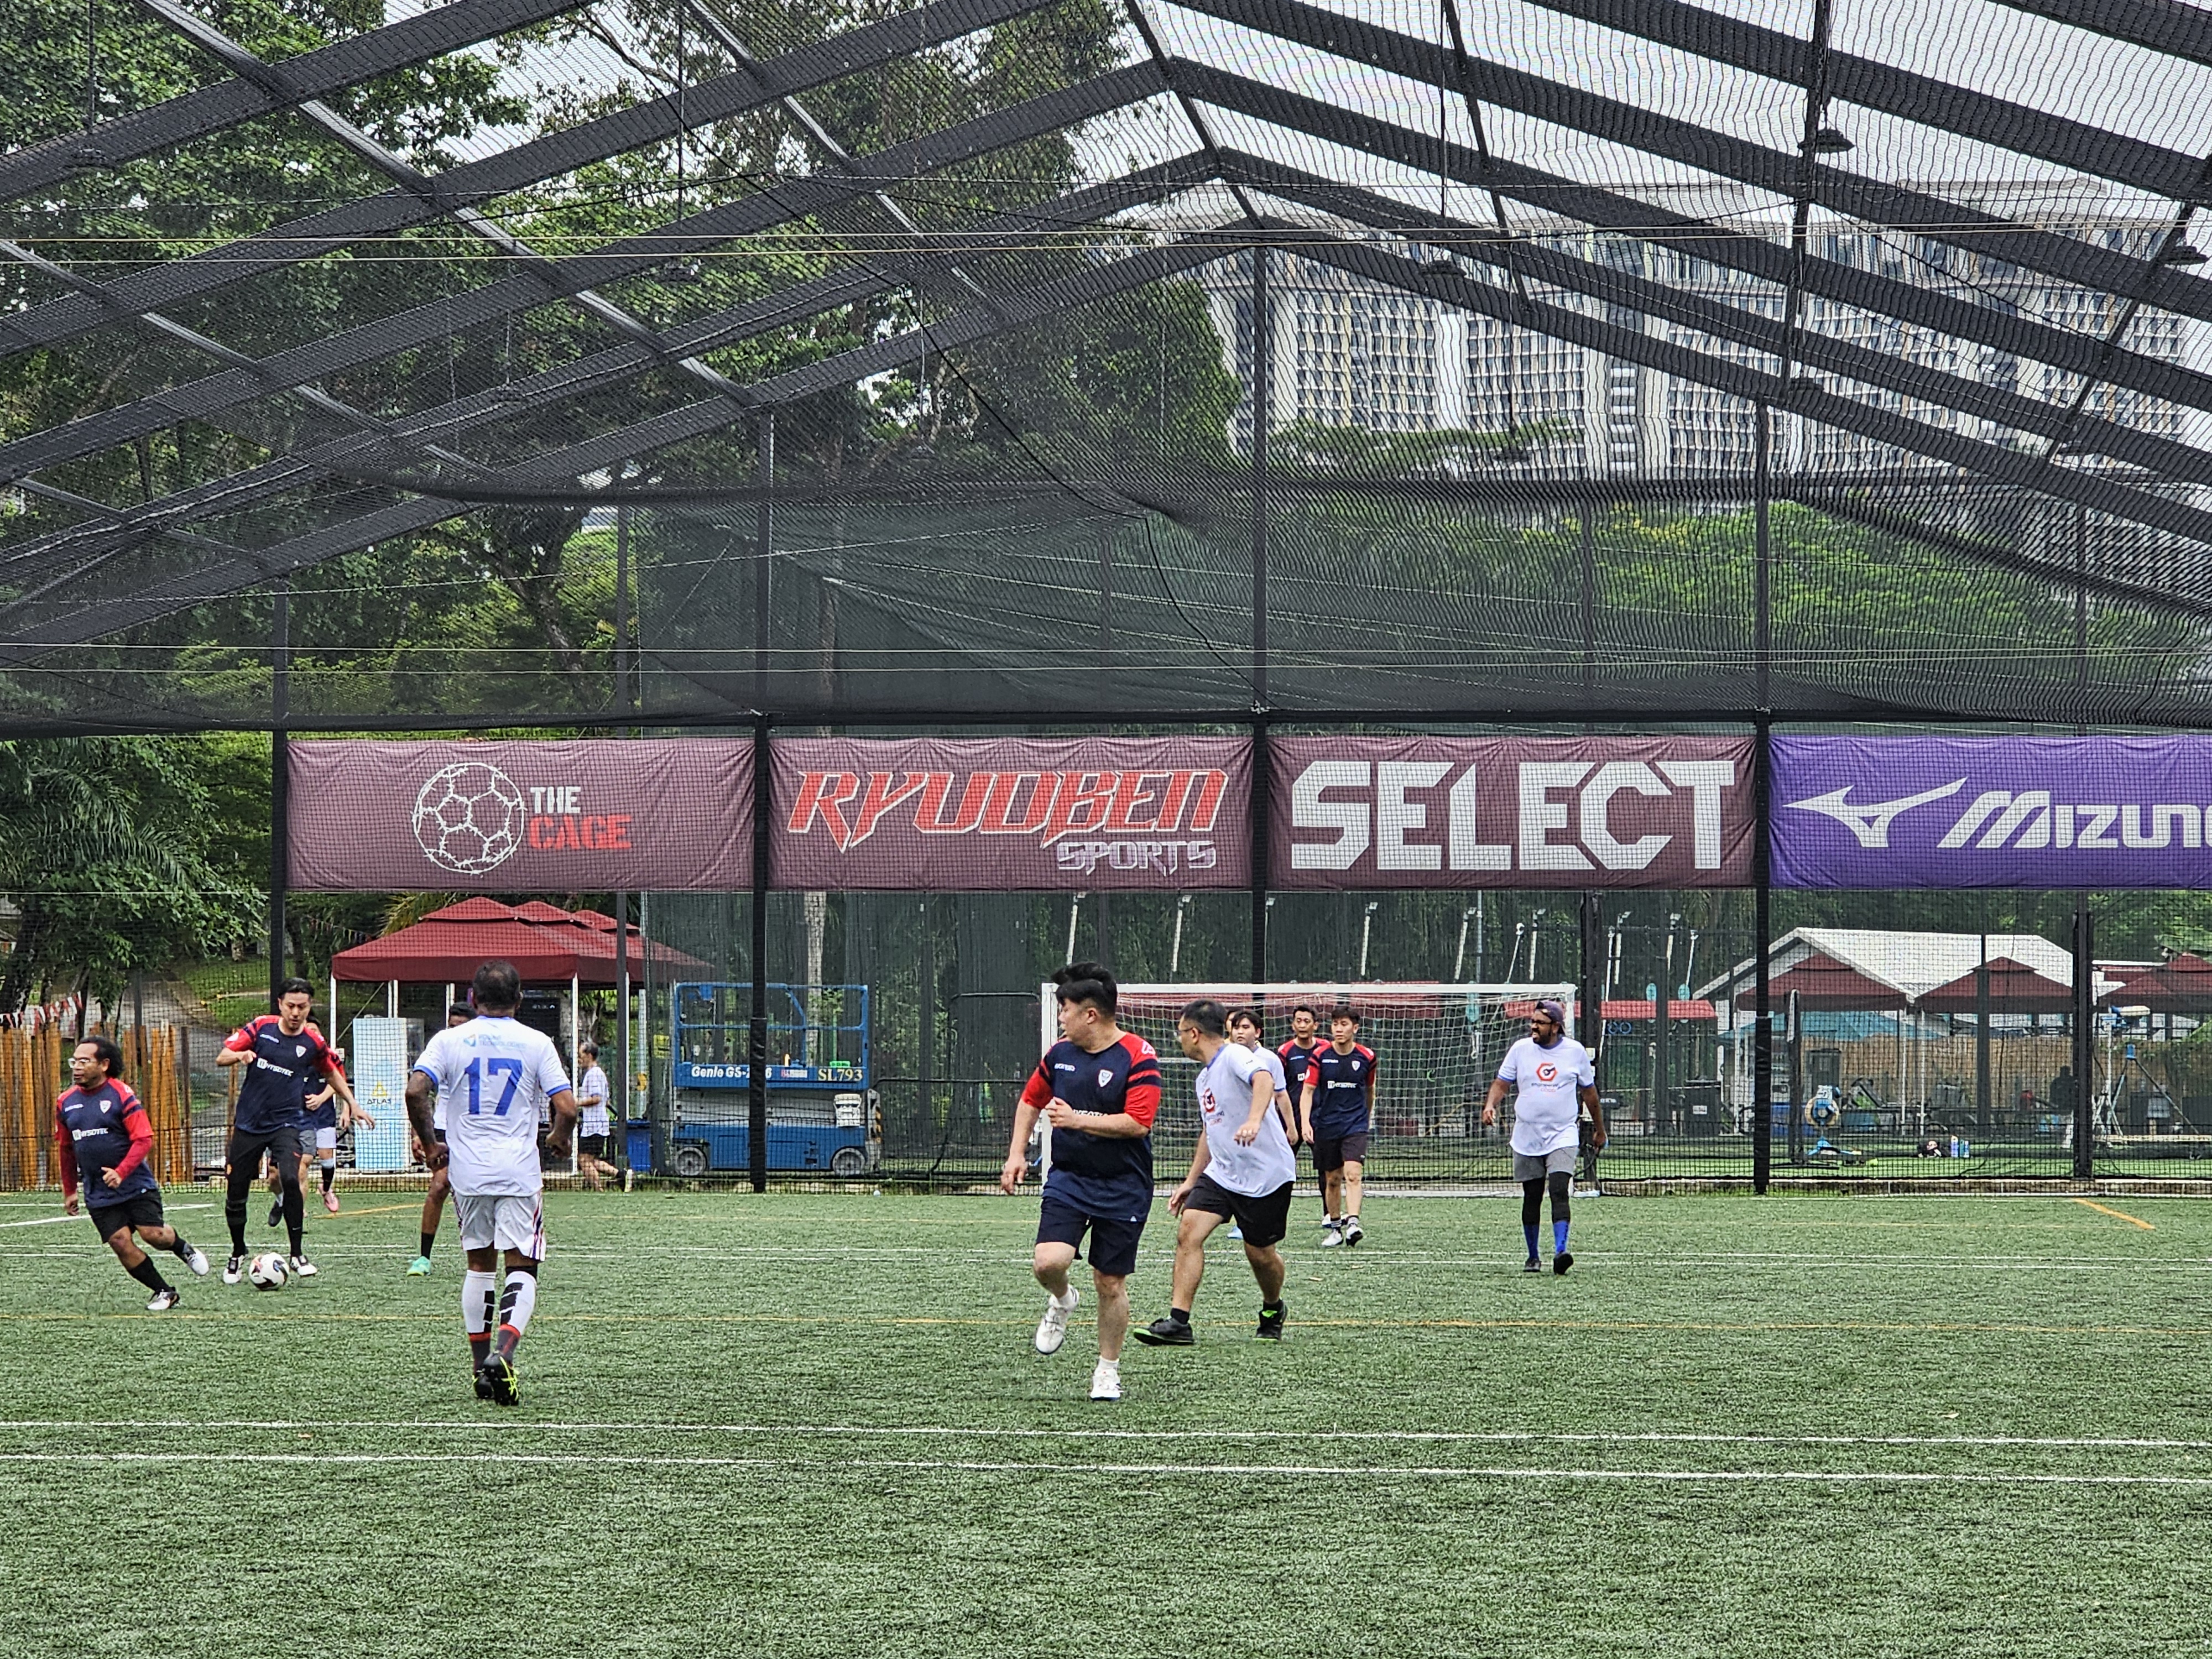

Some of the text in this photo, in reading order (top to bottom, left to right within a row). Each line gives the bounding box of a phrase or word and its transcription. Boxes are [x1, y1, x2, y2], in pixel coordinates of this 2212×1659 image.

[530, 786, 581, 814] THE
[1291, 760, 1735, 870] SELECT
[529, 815, 632, 849] CAGE
[1937, 791, 2212, 848] MIZUN
[1057, 840, 1216, 877] SPORTS
[465, 1057, 523, 1116] 17
[691, 1066, 724, 1078] Genie
[817, 1068, 863, 1082] SL793
